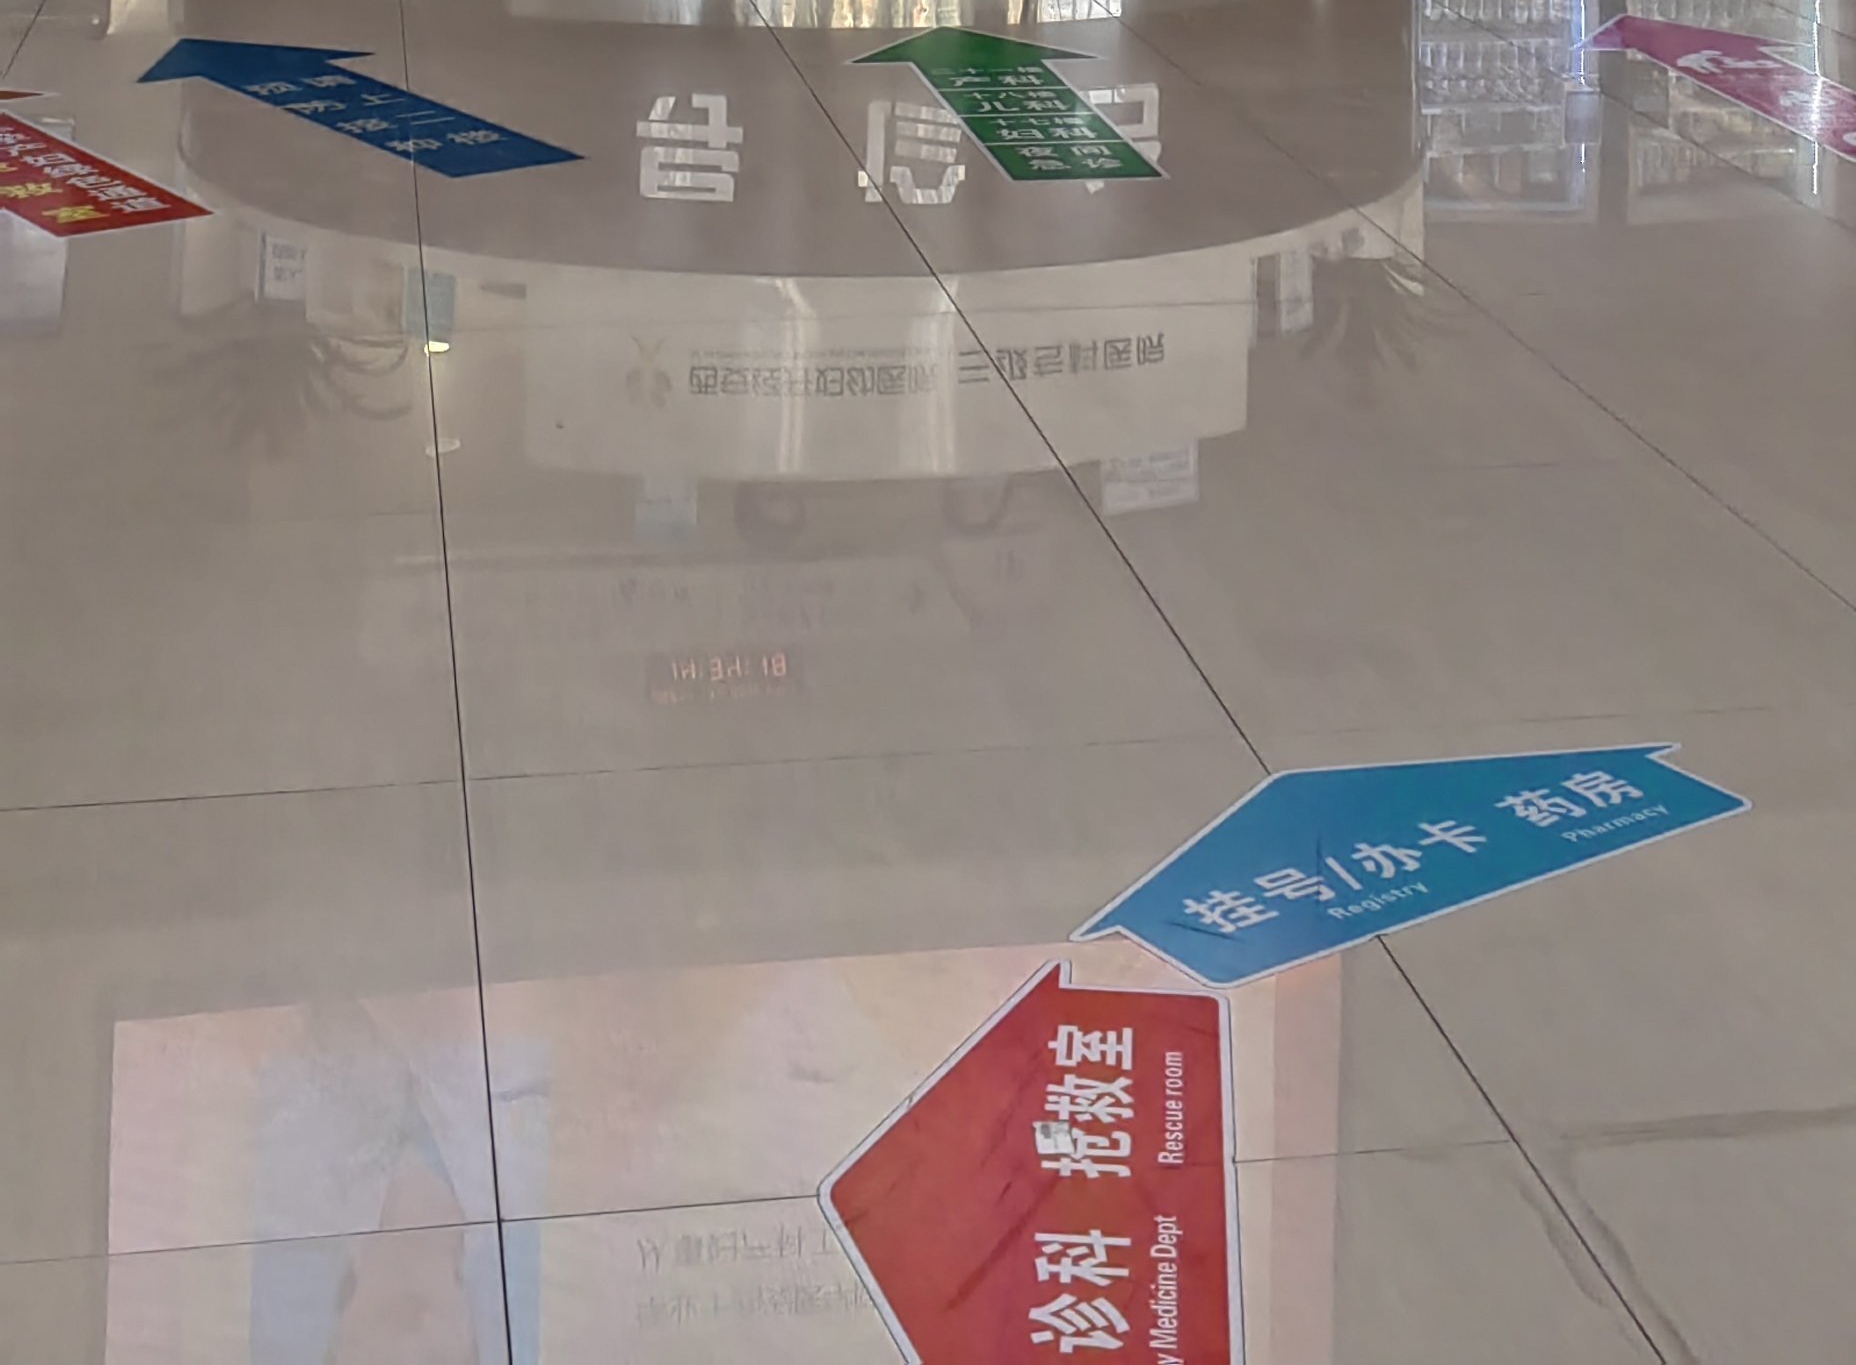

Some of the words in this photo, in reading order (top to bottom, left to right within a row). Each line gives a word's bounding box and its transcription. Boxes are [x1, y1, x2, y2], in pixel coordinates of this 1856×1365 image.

[950, 75, 1044, 86] 产科
[979, 99, 1069, 113] 儿科
[997, 127, 1098, 140] 妇科
[1182, 820, 1487, 934] 挂号/办卡
[1494, 770, 1645, 828] 药房
[1326, 881, 1429, 920] Registry
[1561, 804, 1670, 843] Pharmacy
[1041, 1025, 1135, 1178] 抢救室
[1165, 1051, 1185, 1096] room
[1157, 1100, 1184, 1164] Rescue
[1150, 1214, 1184, 1258] Dept
[1028, 1229, 1132, 1354] 诊科
[1149, 1261, 1178, 1350] Medicine
